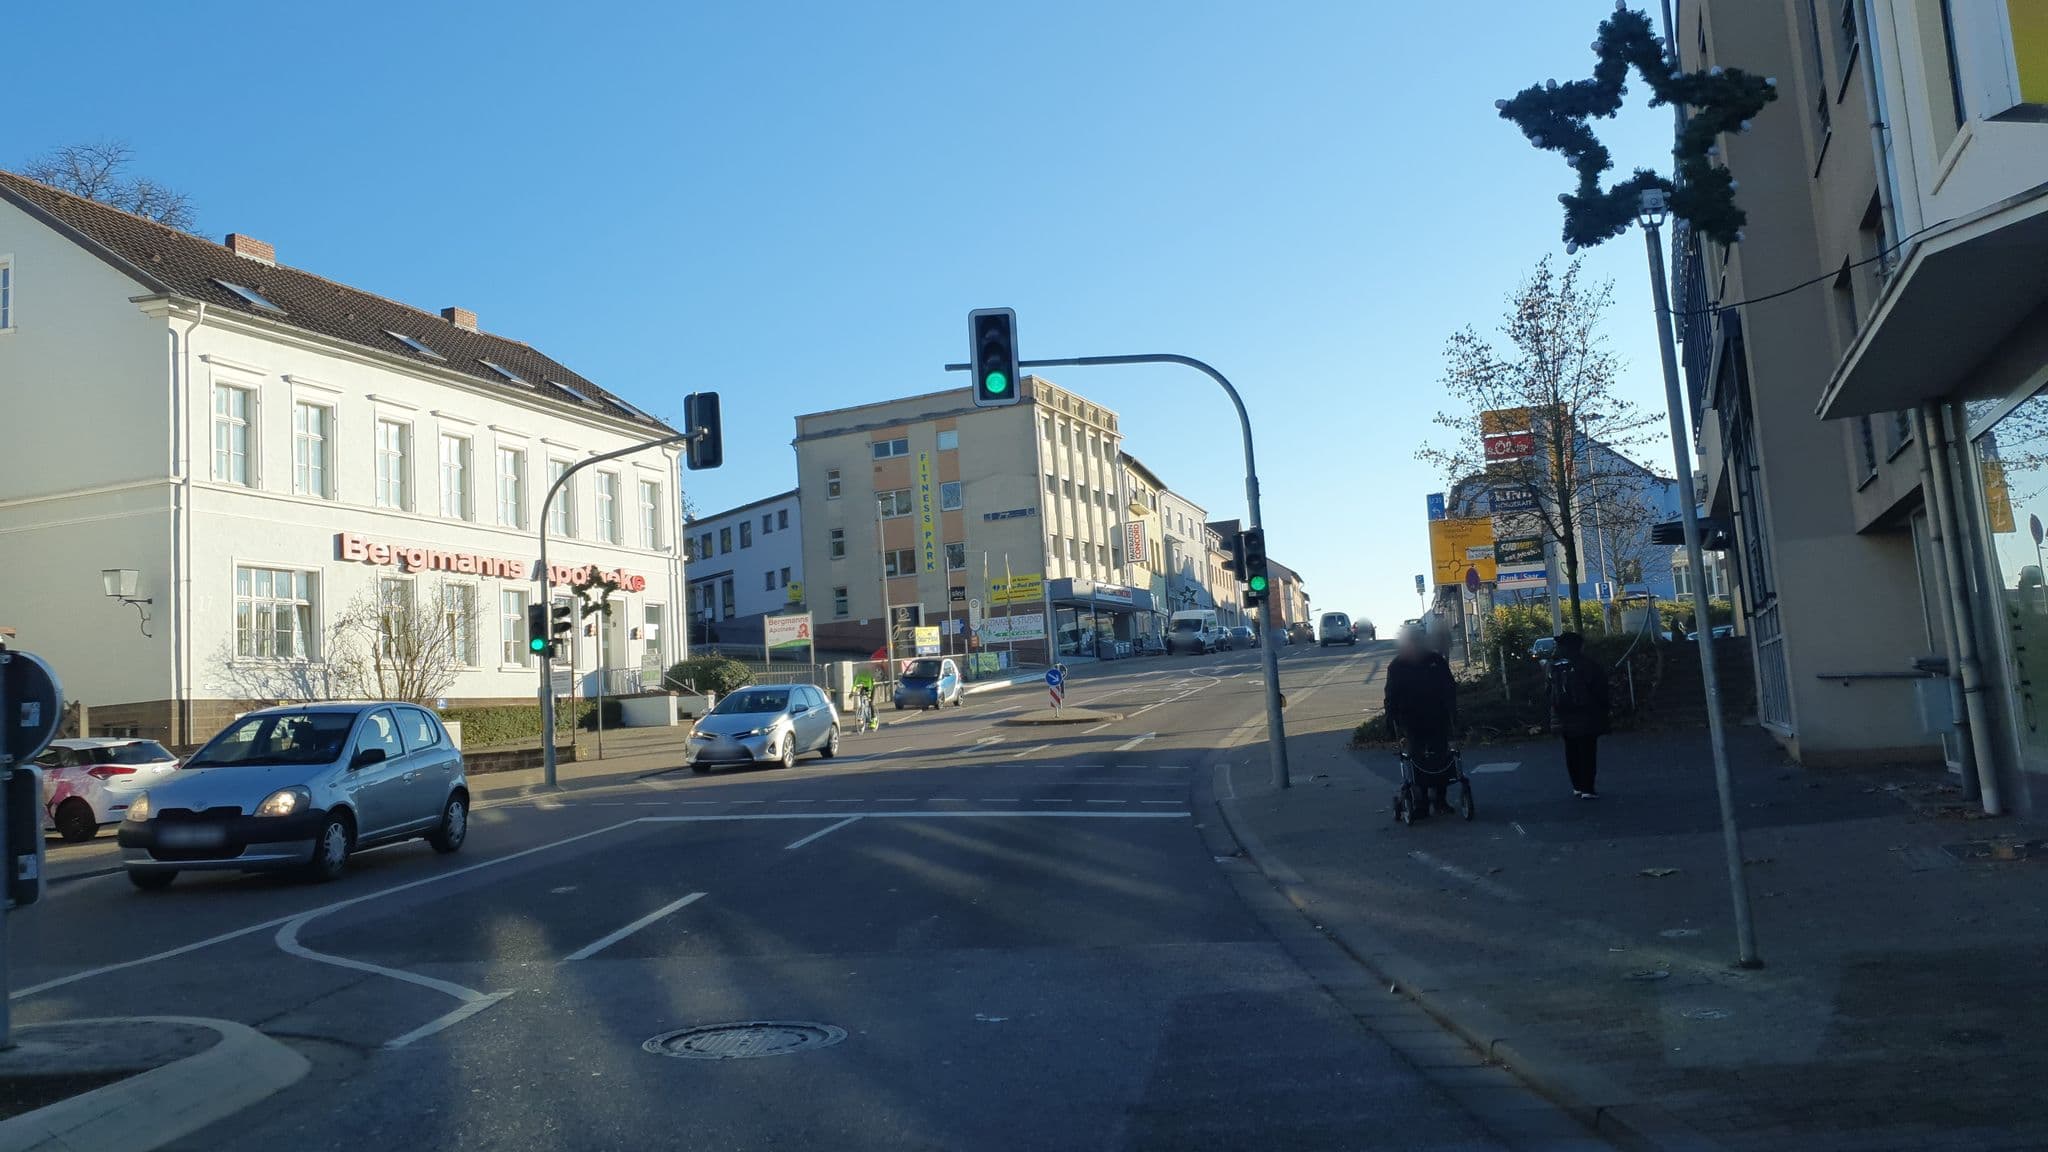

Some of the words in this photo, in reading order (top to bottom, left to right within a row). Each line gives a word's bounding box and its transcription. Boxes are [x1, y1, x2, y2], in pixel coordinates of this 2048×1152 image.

[919, 453, 931, 523] FITNESS
[338, 531, 525, 578] Bergmanns
[924, 531, 936, 570] PARK
[1127, 523, 1136, 561] MATRATZEN
[1133, 523, 1142, 560] CONCORD
[768, 615, 809, 626] Bergmanns
